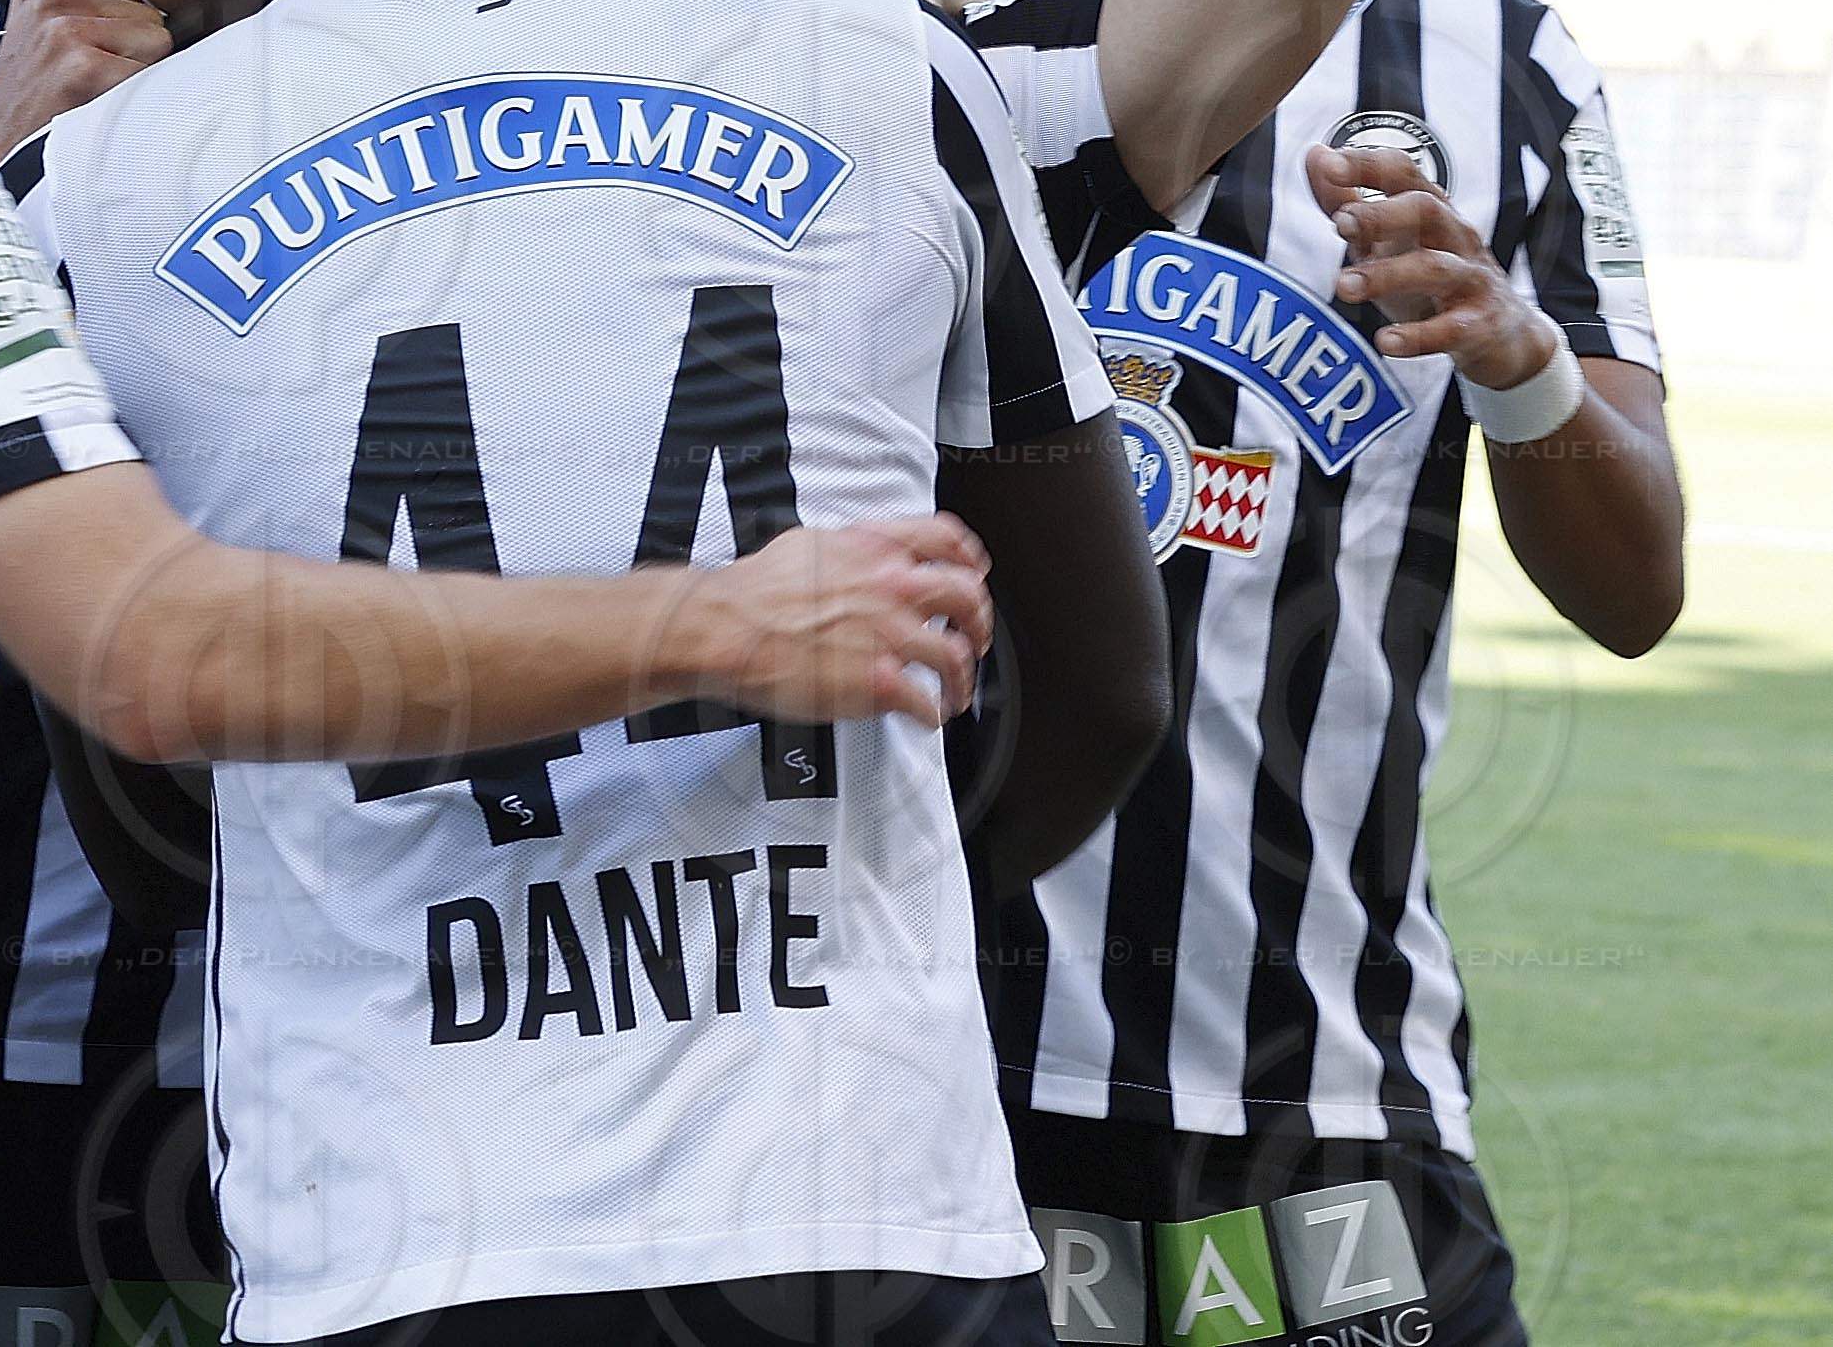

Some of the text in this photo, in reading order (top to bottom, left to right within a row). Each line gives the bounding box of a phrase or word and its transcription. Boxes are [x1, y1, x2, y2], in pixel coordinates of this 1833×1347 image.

[191, 95, 812, 301] PUNTIGAMER
[339, 285, 839, 847] 44
[427, 844, 831, 1046] DANTE
